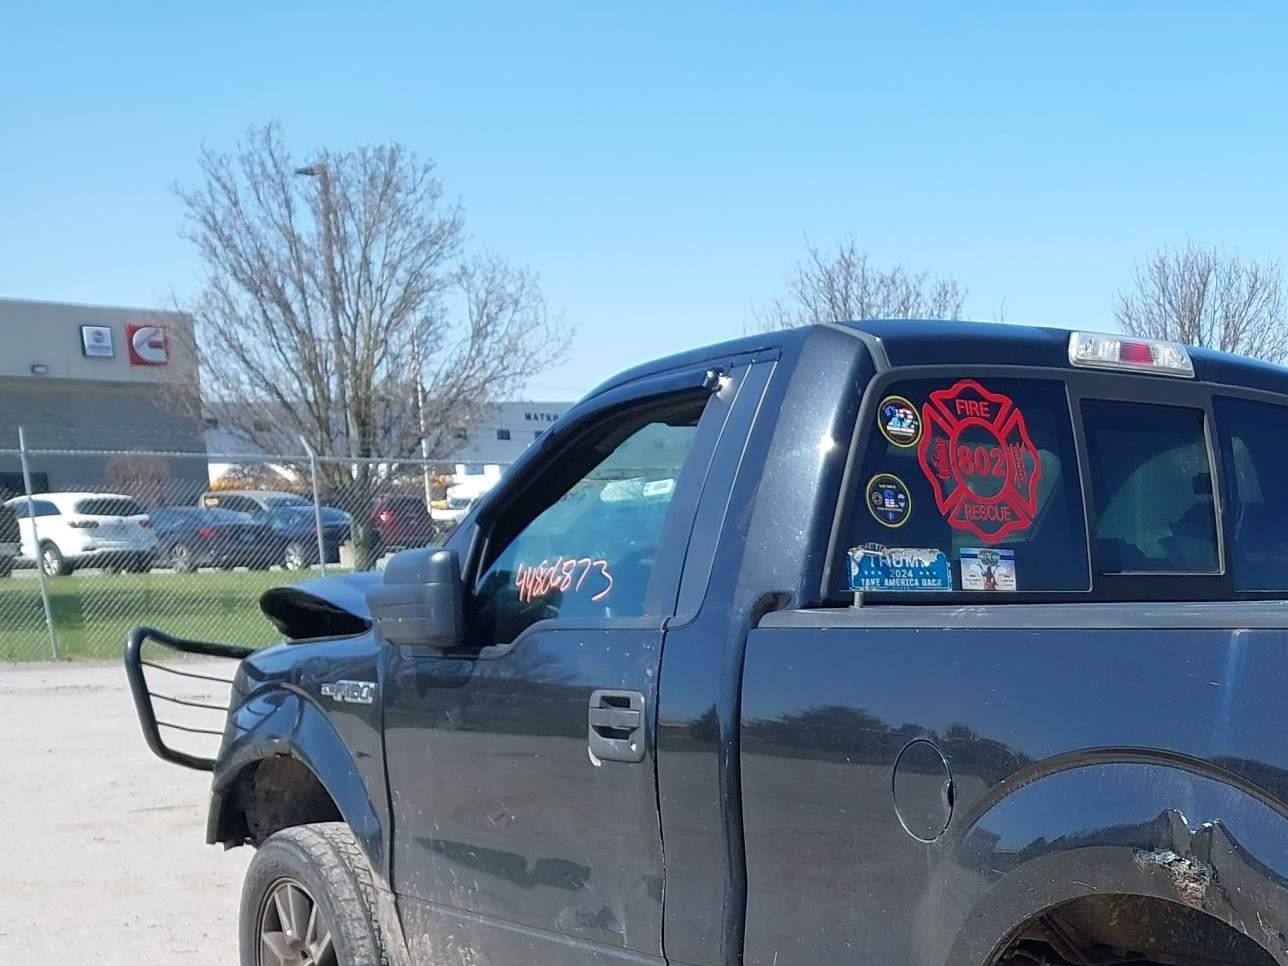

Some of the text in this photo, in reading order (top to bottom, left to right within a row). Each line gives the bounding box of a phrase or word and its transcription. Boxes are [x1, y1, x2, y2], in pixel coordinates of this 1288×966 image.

[955, 399, 990, 417] FIRE
[957, 445, 1006, 477] 802
[964, 504, 1011, 521] RESCUE
[515, 556, 613, 604] 44806873
[889, 569, 913, 578] 2024
[861, 578, 881, 587] TAKE
[884, 578, 919, 587] AMERICA
